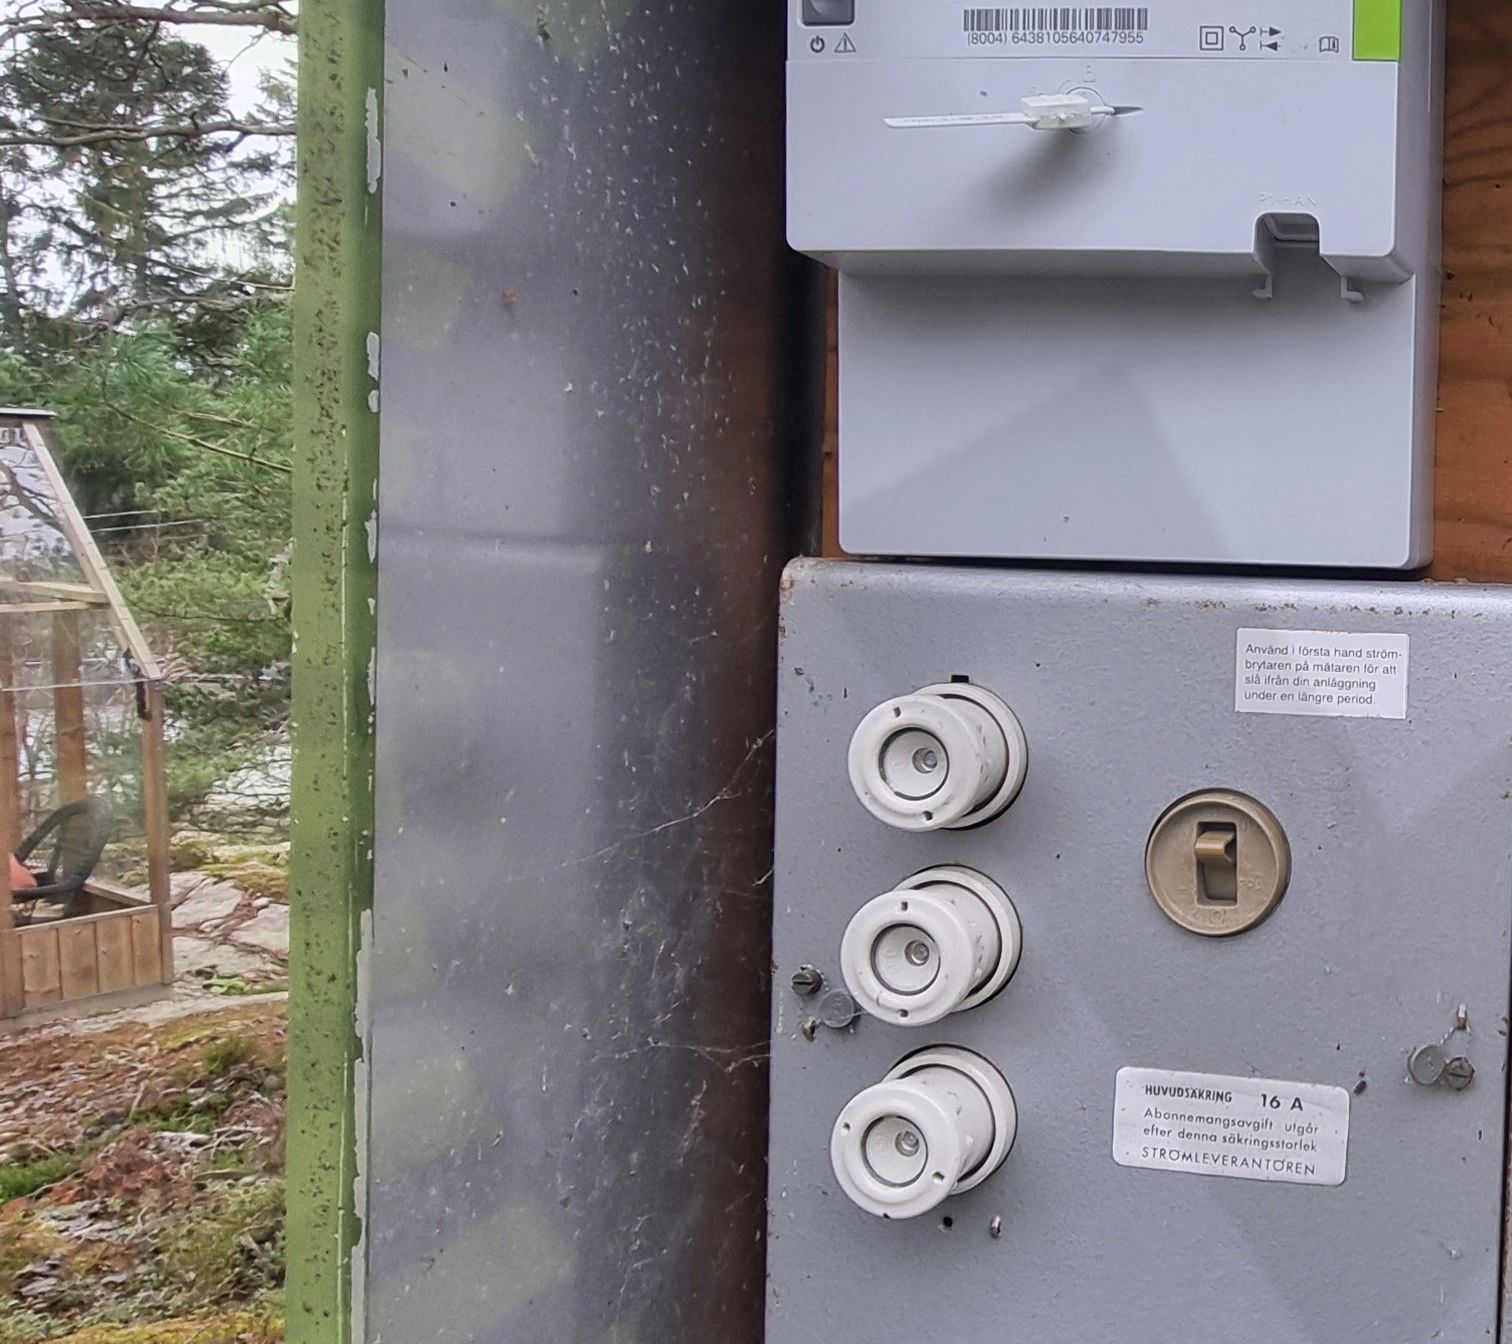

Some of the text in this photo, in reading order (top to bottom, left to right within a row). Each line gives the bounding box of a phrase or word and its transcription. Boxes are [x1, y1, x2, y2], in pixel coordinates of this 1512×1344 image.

[967, 31, 1008, 47] (8004)
[1245, 644, 1288, 656] Använd
[1298, 645, 1330, 657] första
[1334, 647, 1362, 658] hand
[1245, 660, 1397, 674] brytaren på mätaren för att
[1245, 673, 1376, 691] slå ifrån din anläggning
[1244, 689, 1277, 700] under
[1280, 692, 1294, 701] en
[1298, 690, 1333, 705] längre
[1145, 1084, 1304, 1111] HUVUDSÄKRING 16 A
[1143, 1107, 1319, 1136] Abonnemangsavgift utgår
[1143, 1125, 1317, 1152] efter denna säkringsstorlek
[1141, 1146, 1316, 1175] STRÖMLEVERANTÖREN
